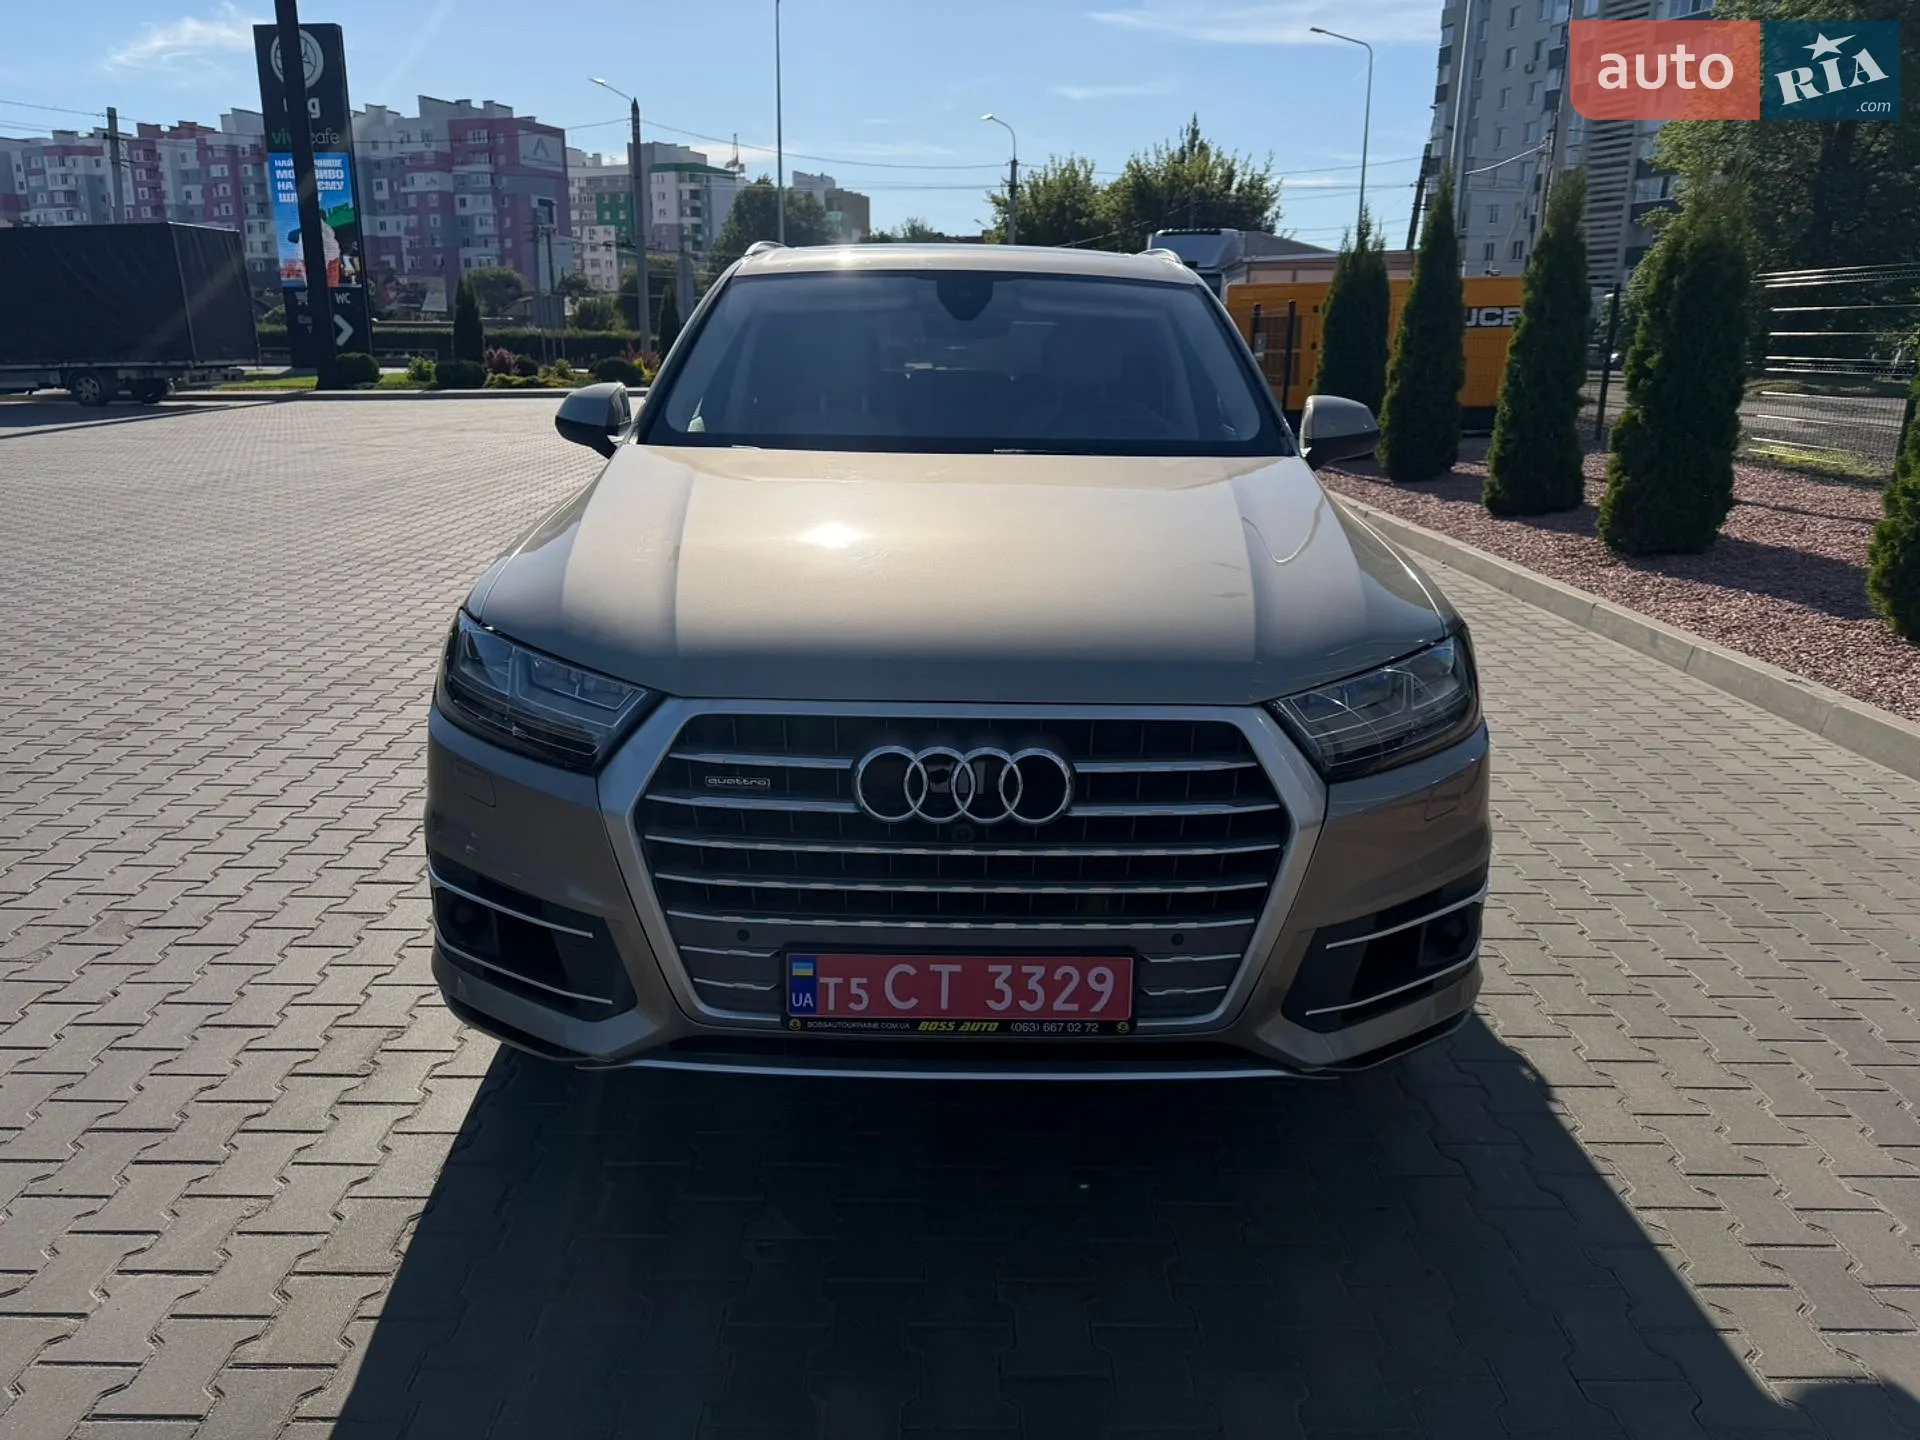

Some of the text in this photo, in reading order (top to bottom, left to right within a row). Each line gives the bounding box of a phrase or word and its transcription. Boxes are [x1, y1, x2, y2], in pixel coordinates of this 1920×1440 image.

[335, 292, 351, 304] WC
[706, 777, 768, 786] quattro
[819, 977, 870, 1011] T5
[985, 964, 1114, 1013] 3329
[791, 992, 814, 1007] UA
[917, 1021, 956, 1031] BOSS
[1010, 1022, 1040, 1033] (063)
[1043, 1022, 1063, 1033] 667
[1067, 1022, 1081, 1033] 02
[1085, 1022, 1099, 1033] 72
